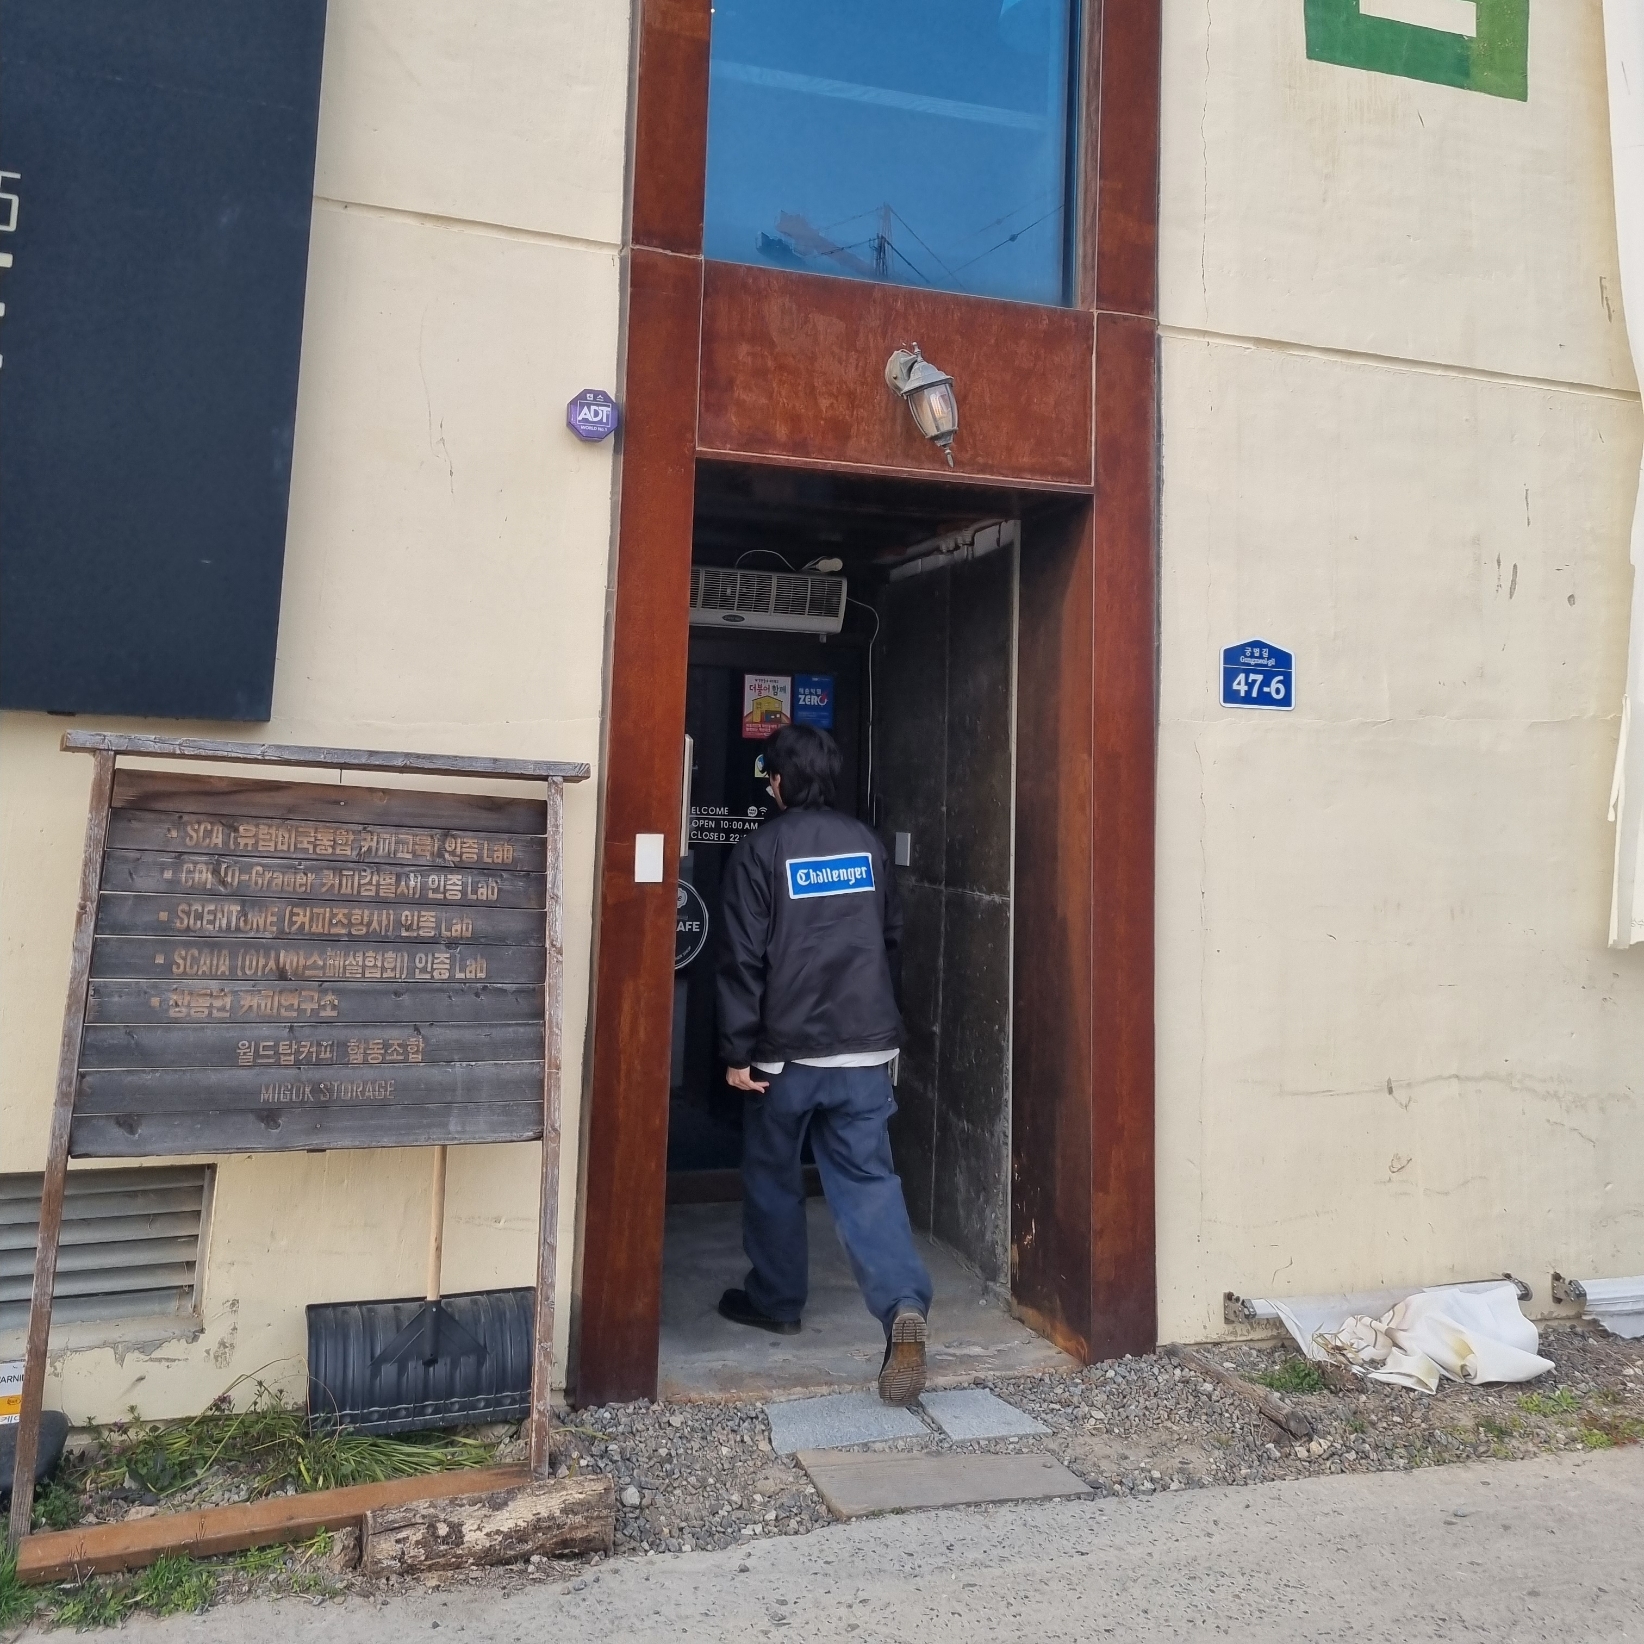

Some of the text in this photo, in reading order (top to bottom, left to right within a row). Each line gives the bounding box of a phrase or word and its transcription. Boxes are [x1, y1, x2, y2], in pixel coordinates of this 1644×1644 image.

[578, 405, 611, 422] ADT
[749, 683, 770, 697] 더불어
[1232, 673, 1286, 700] 47-6
[798, 694, 829, 706] ZERO
[691, 806, 729, 815] ELCOME
[691, 820, 715, 828] OPEN
[185, 821, 224, 849] SCA
[444, 835, 479, 863] 인증
[483, 839, 514, 864] Lab
[690, 831, 726, 841] CLOSED
[796, 866, 868, 886] Challenger
[427, 873, 463, 900] 인증
[467, 875, 499, 901] Lab
[400, 910, 437, 937] 인증
[440, 911, 474, 938] Lab
[676, 921, 701, 932] AFE
[414, 952, 450, 980] 인증
[454, 952, 488, 980] Lab
[236, 1039, 338, 1066] 월드탑커피
[319, 1080, 396, 1101] STORAGE
[0, 1374, 25, 1384] ARNI
